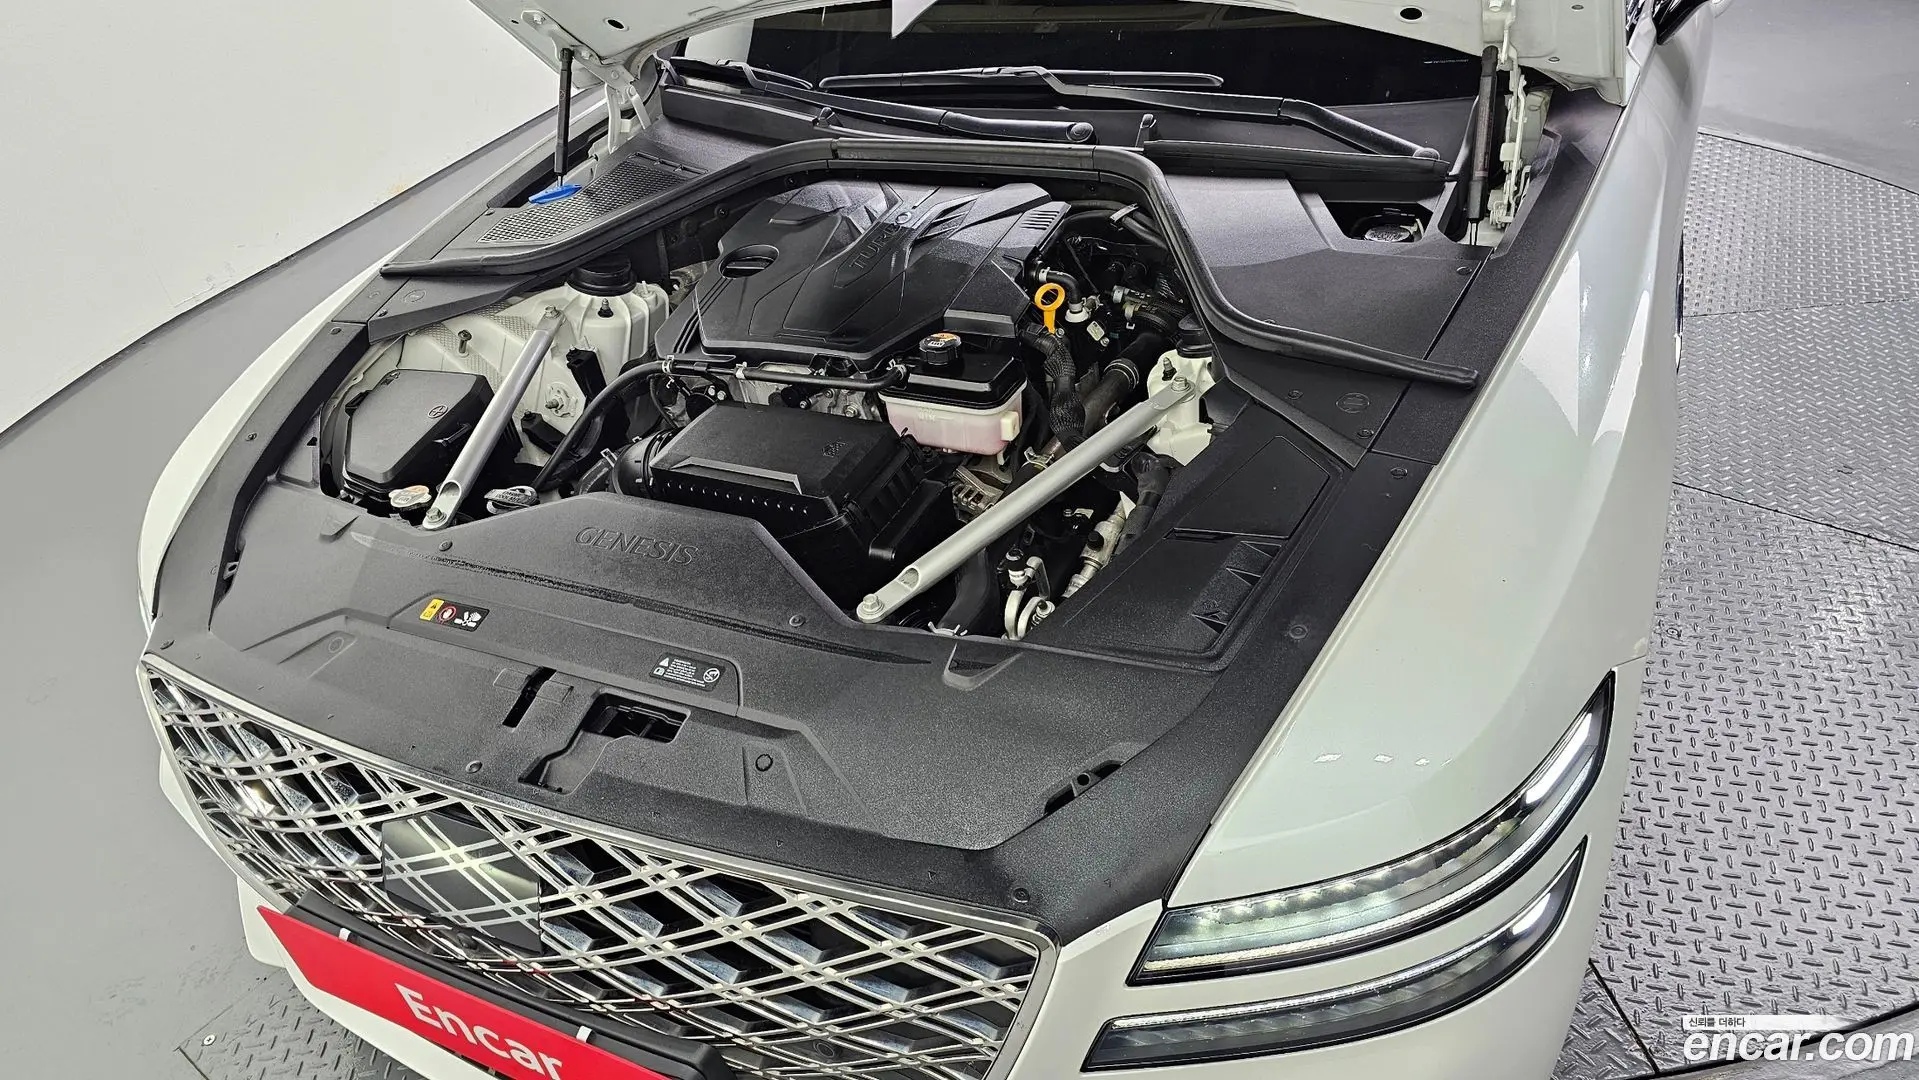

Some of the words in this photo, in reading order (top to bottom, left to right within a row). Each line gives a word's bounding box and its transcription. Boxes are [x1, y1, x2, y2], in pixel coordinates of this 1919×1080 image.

[849, 211, 912, 268] TURBO
[575, 526, 699, 565] GENESIS
[394, 983, 563, 1080] Encar
